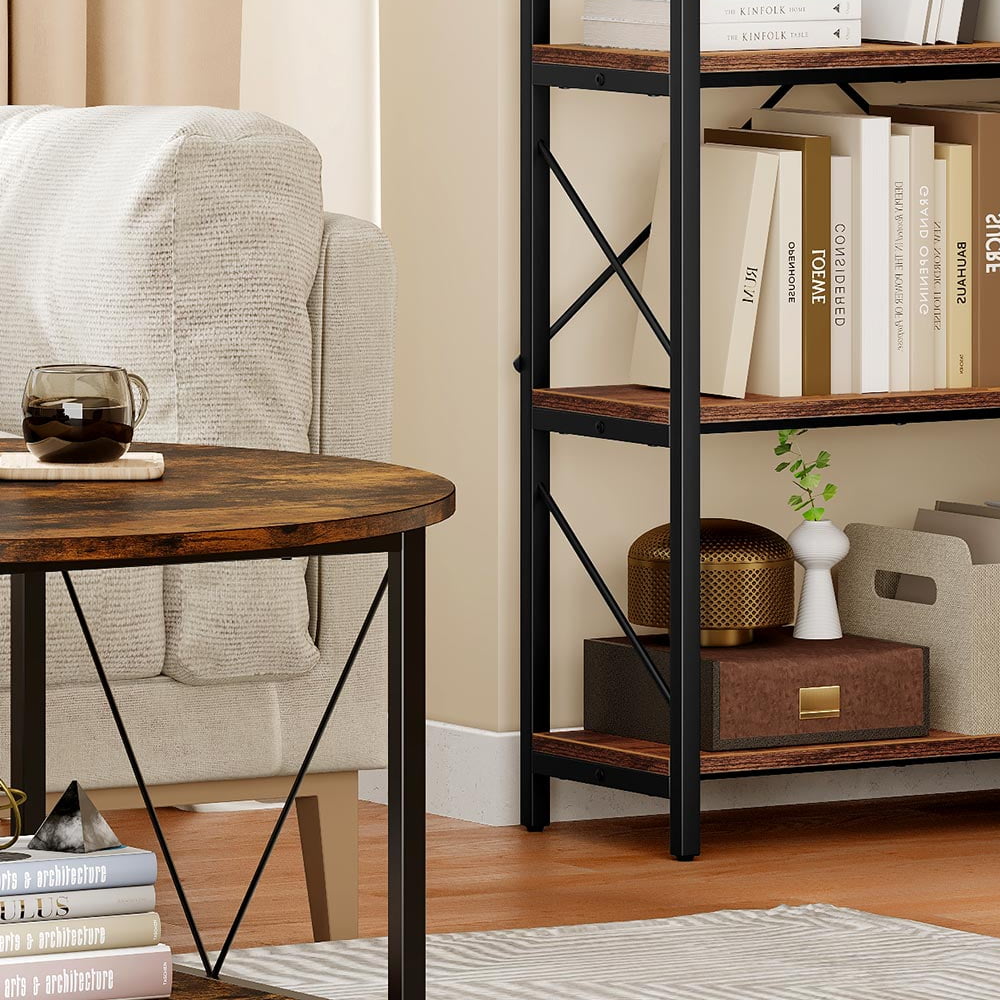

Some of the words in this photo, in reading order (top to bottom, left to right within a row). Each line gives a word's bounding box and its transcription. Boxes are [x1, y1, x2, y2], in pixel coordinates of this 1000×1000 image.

[740, 6, 786, 16] KINFOLK
[742, 31, 787, 42] KINFOLK
[0, 869, 18, 891] rts
[24, 871, 32, 889] &
[37, 864, 107, 887] architecture
[26, 933, 34, 950] &
[39, 926, 106, 950] architecture
[4, 973, 27, 998] arts
[33, 975, 41, 996] &
[45, 968, 114, 995] architecture
